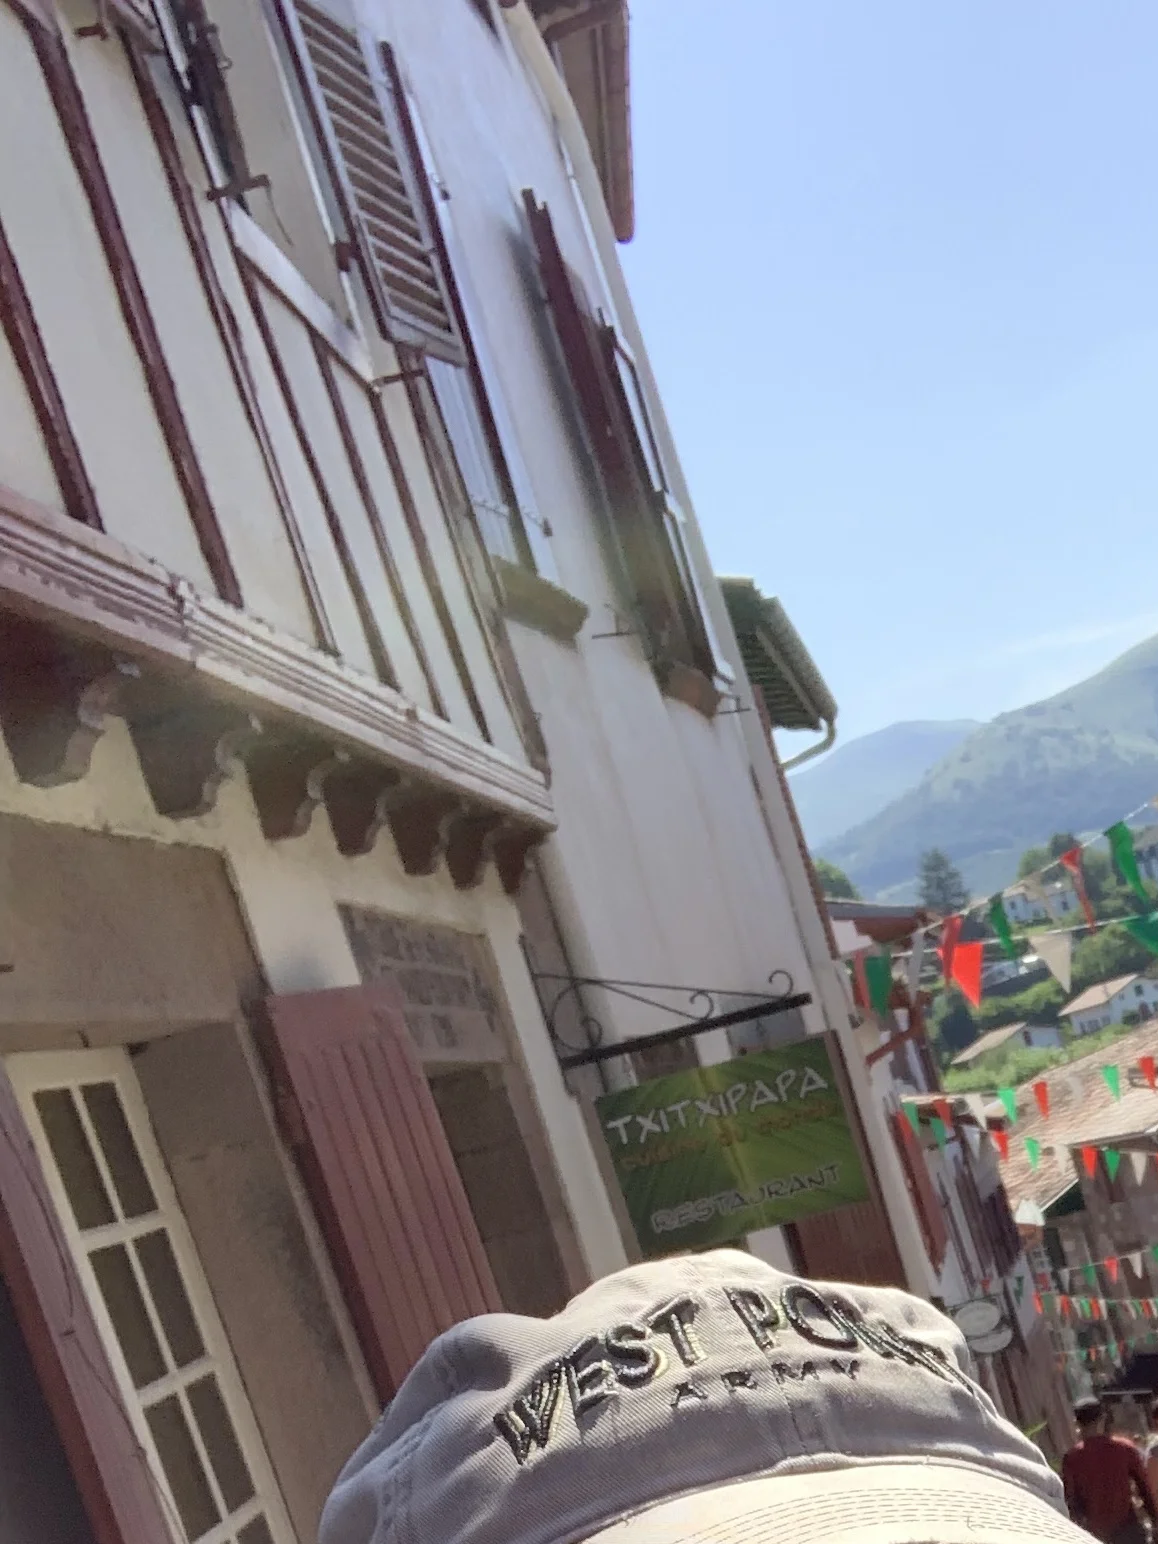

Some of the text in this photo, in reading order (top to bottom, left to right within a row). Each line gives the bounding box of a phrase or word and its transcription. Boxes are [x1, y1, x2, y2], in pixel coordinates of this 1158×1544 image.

[606, 1067, 828, 1144] TXITXIPAPA
[651, 1163, 841, 1234] RESTAURANT
[493, 1291, 699, 1465] WEST
[670, 1359, 860, 1408] ARMY
